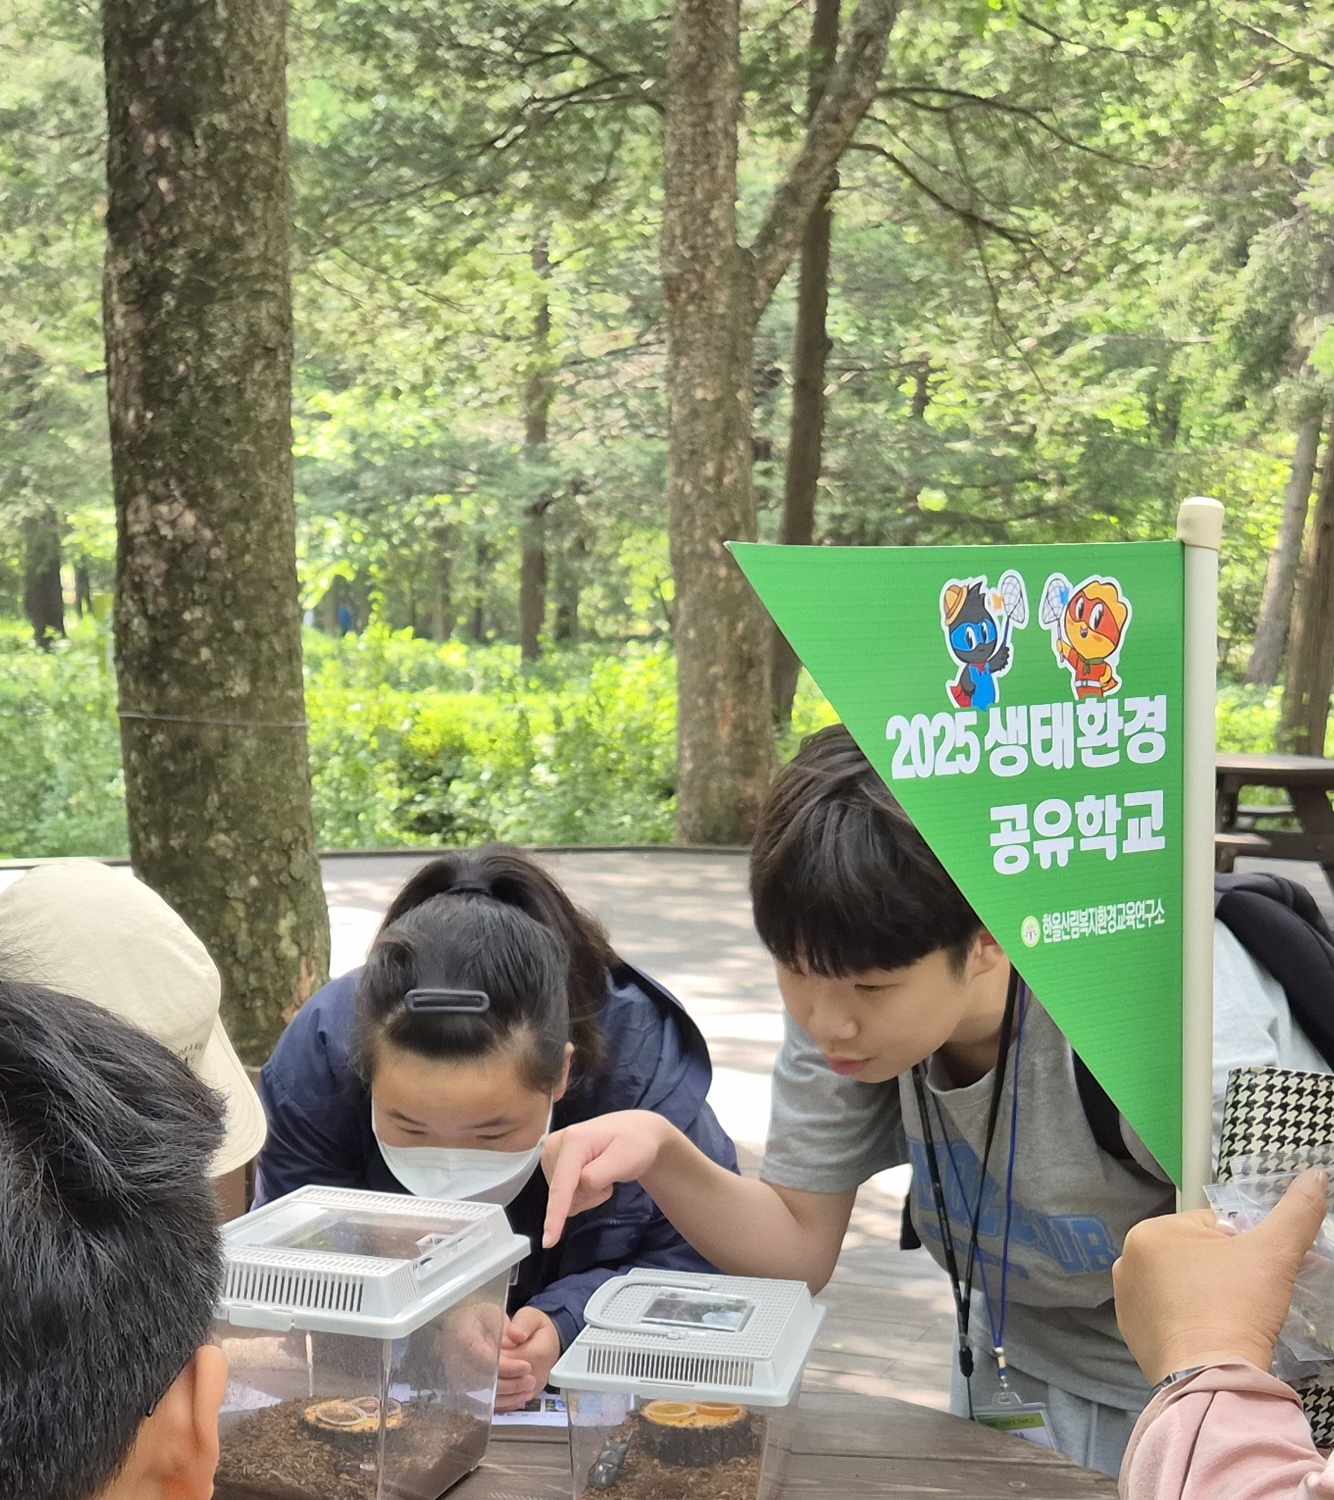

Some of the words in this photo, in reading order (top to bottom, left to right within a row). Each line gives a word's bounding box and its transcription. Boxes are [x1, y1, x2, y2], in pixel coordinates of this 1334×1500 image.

[885, 711, 981, 780] 2025
[984, 695, 1167, 777] 생태환경
[989, 789, 1166, 875] 공유학교
